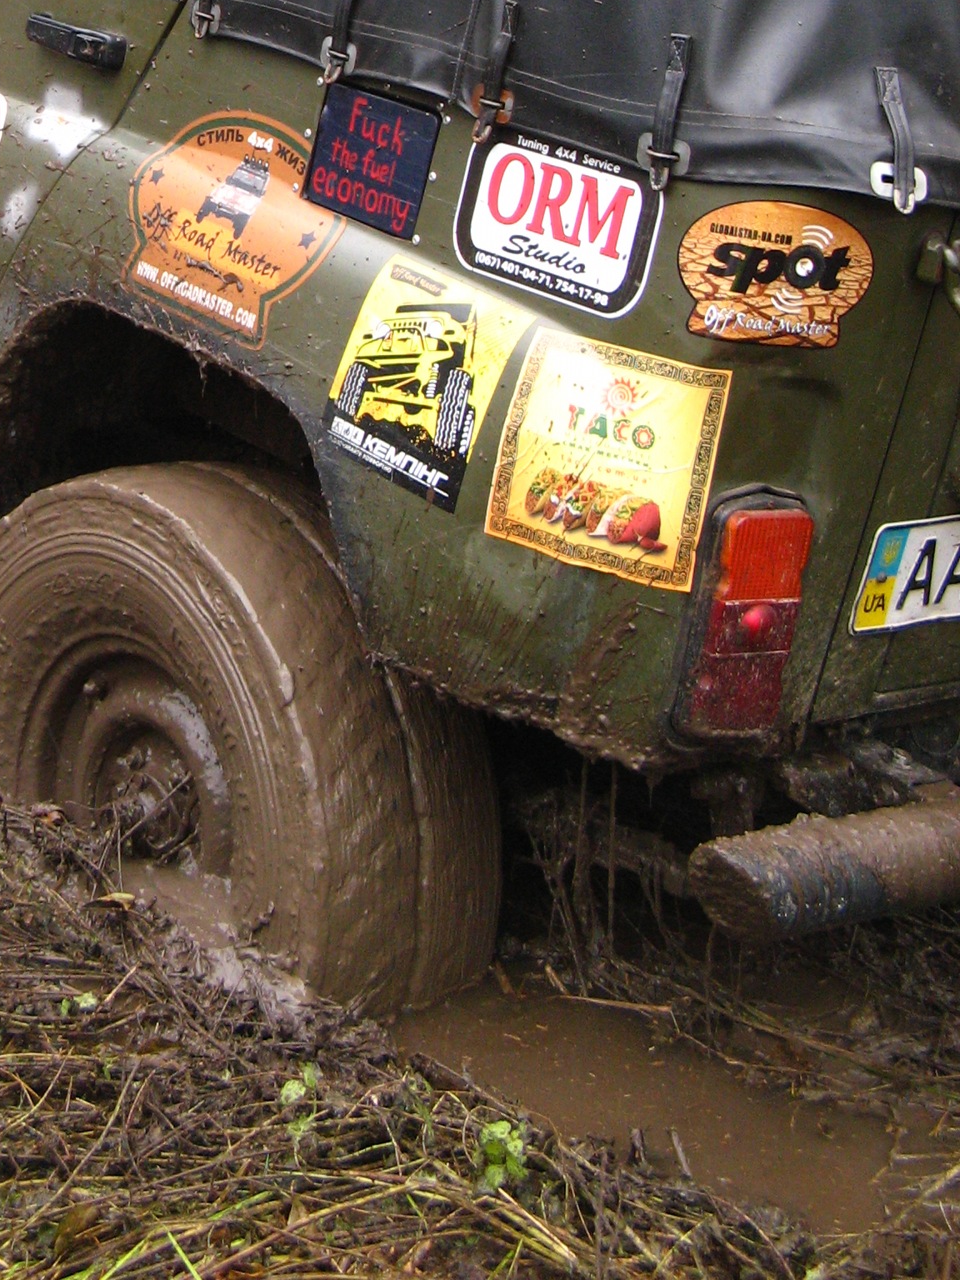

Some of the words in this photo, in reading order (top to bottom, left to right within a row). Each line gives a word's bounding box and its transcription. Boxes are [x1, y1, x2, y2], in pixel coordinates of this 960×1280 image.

[197, 128, 245, 147] СТИЛЬ
[348, 96, 407, 157] Fuck
[330, 137, 359, 172] the
[362, 148, 397, 187] fuel
[517, 134, 550, 156] Tuning
[582, 155, 622, 174] Service
[312, 166, 411, 233] economy
[487, 152, 635, 261] ORM
[175, 219, 220, 261] Road
[221, 239, 282, 279] Master
[502, 234, 587, 274] Studio
[710, 222, 793, 246] GLOBALSTAR-UA.COM
[475, 251, 500, 266] (067)
[555, 278, 609, 306] 754-17-98
[704, 304, 736, 334] Off
[732, 312, 777, 337] Road
[777, 318, 833, 336] Master
[568, 404, 656, 450] TACO
[362, 433, 450, 487] КЕМПІНГ
[863, 594, 886, 613] UA
